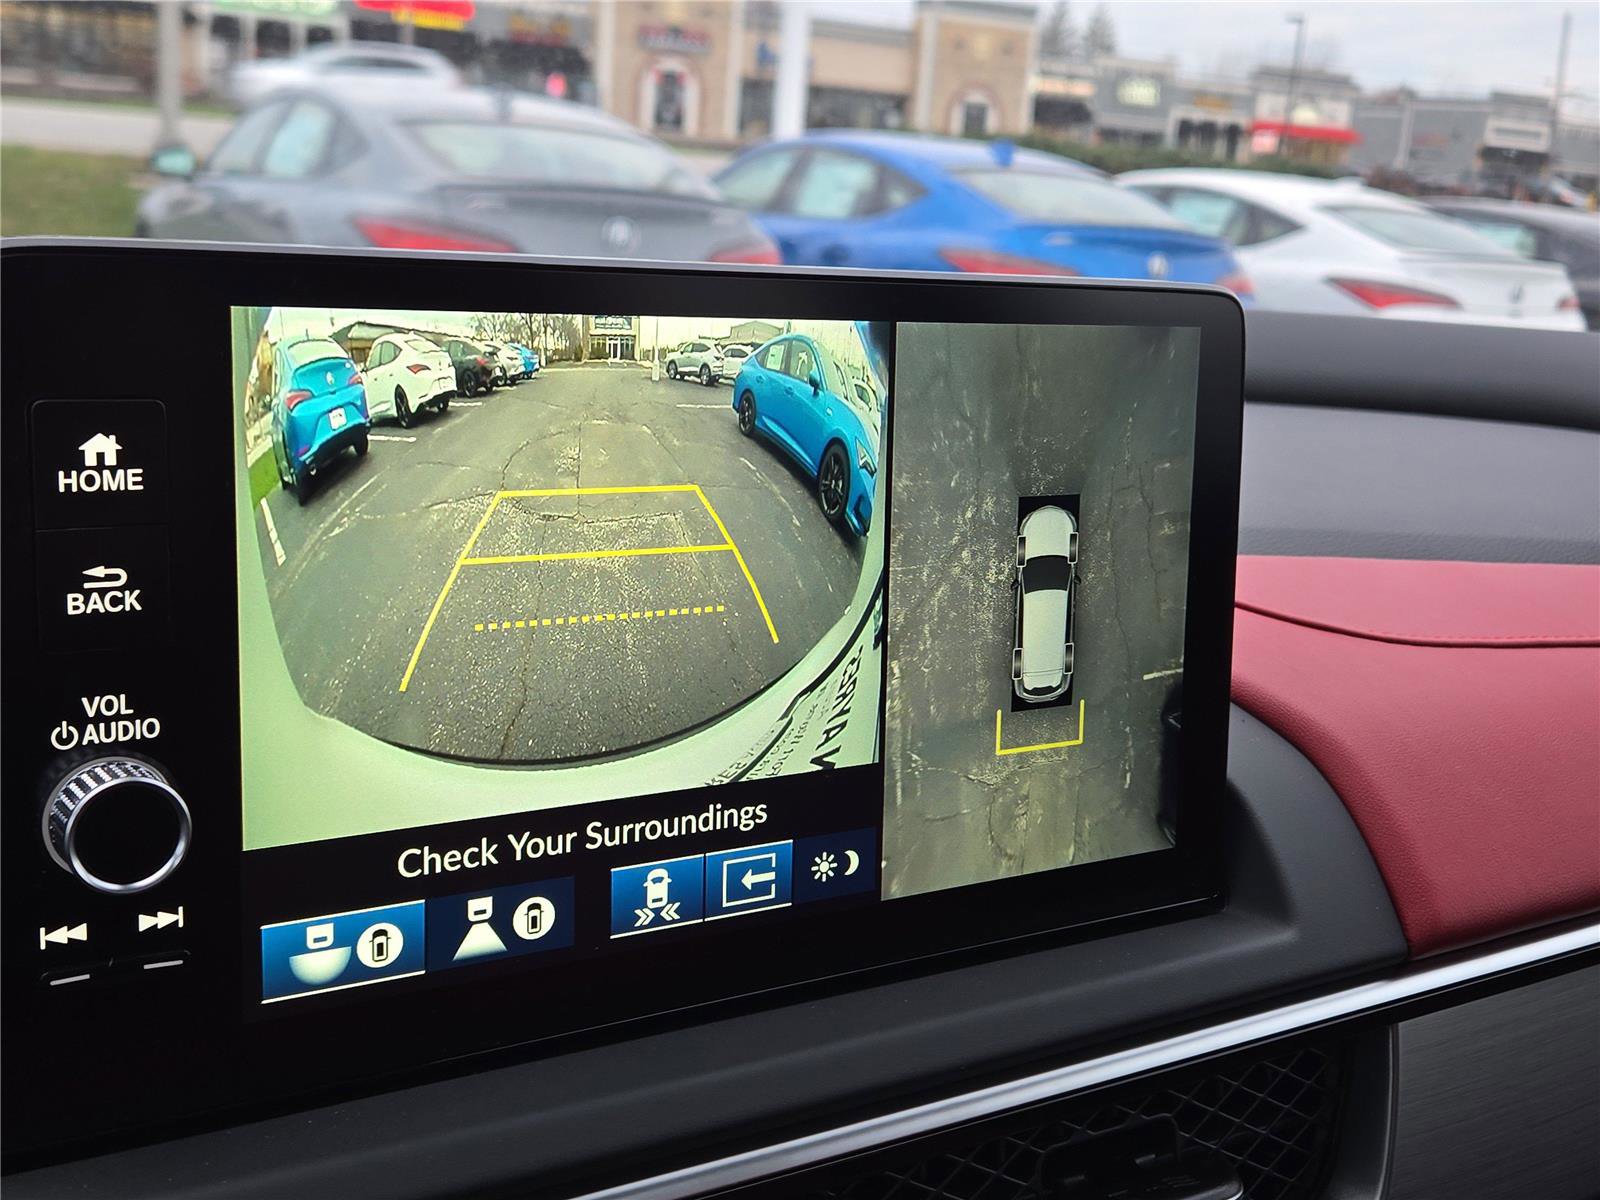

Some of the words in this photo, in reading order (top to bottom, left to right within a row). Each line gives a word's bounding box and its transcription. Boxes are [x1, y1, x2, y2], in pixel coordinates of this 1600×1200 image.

[58, 468, 145, 493] HOME
[66, 589, 143, 616] BACK
[81, 693, 135, 719] VOL
[82, 717, 162, 746] AUDIO
[397, 837, 499, 879] Check
[508, 829, 578, 862] Your
[585, 802, 768, 850] Surroundings
